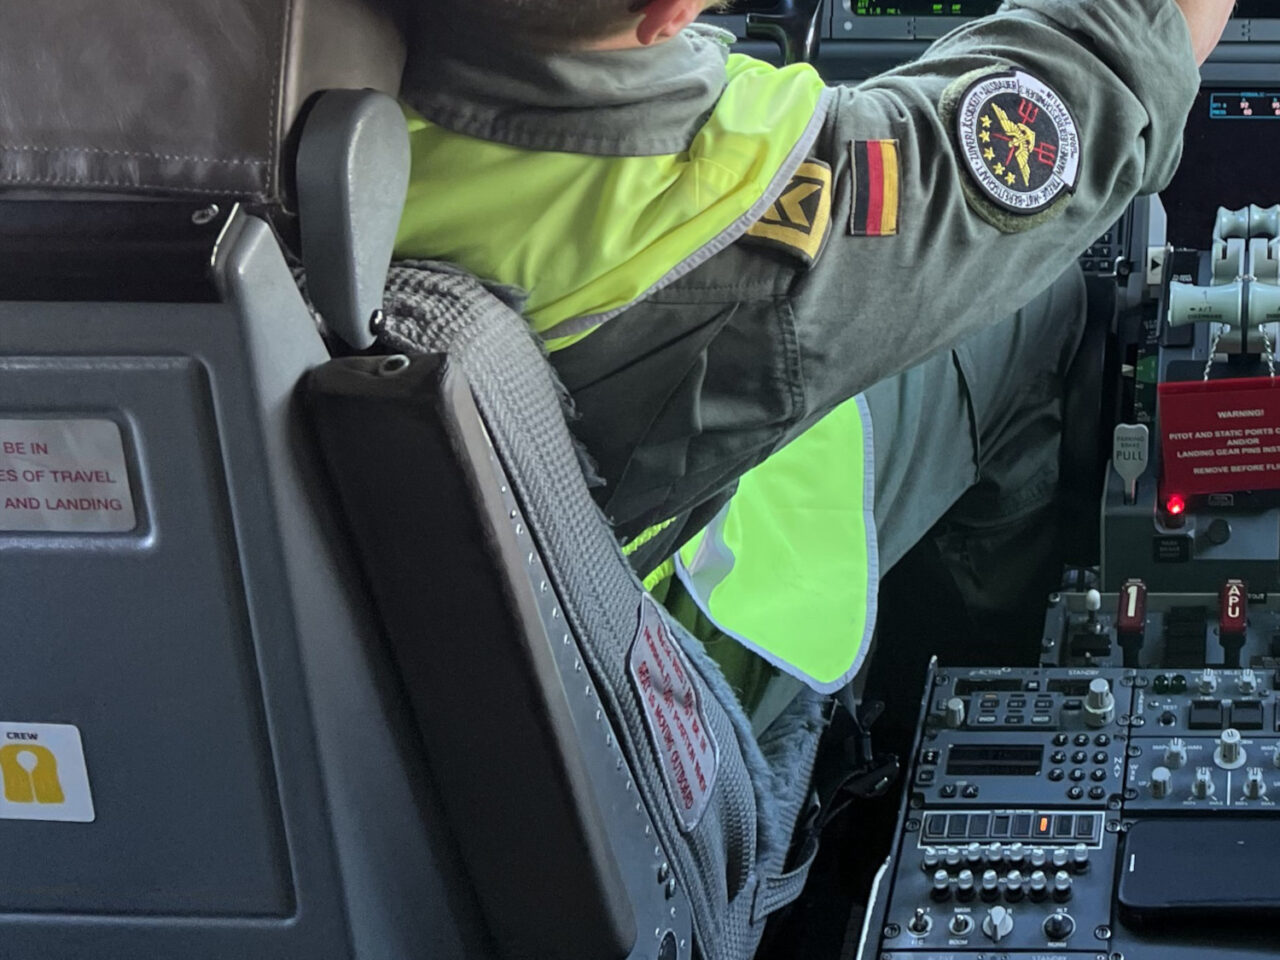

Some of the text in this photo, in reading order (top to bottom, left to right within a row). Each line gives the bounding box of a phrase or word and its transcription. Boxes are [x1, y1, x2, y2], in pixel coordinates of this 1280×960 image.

[1217, 409, 1264, 419] WARNING!
[1169, 432, 1193, 440] PITOT
[1194, 431, 1212, 439] AND
[1215, 430, 1243, 438] STATIC
[1245, 428, 1273, 437] PORTS
[1227, 438, 1259, 446] AND/OR
[3, 442, 48, 455] BE IN
[1177, 449, 1214, 458] LANDING
[1216, 447, 1240, 456] GEAR
[1242, 446, 1261, 454] PINS
[1116, 450, 1144, 461] PULL
[1193, 466, 1228, 475] REMOVE
[1231, 464, 1264, 473] BEFORE
[23, 470, 46, 482] OF
[50, 470, 116, 483] TRAVEL
[5, 498, 122, 511] AND LANDING
[1127, 585, 1137, 617] 1
[1227, 585, 1240, 618] APU
[6, 732, 38, 740] CREW
[655, 705, 674, 752] MOVING
[672, 751, 693, 809] OUTBOARD
